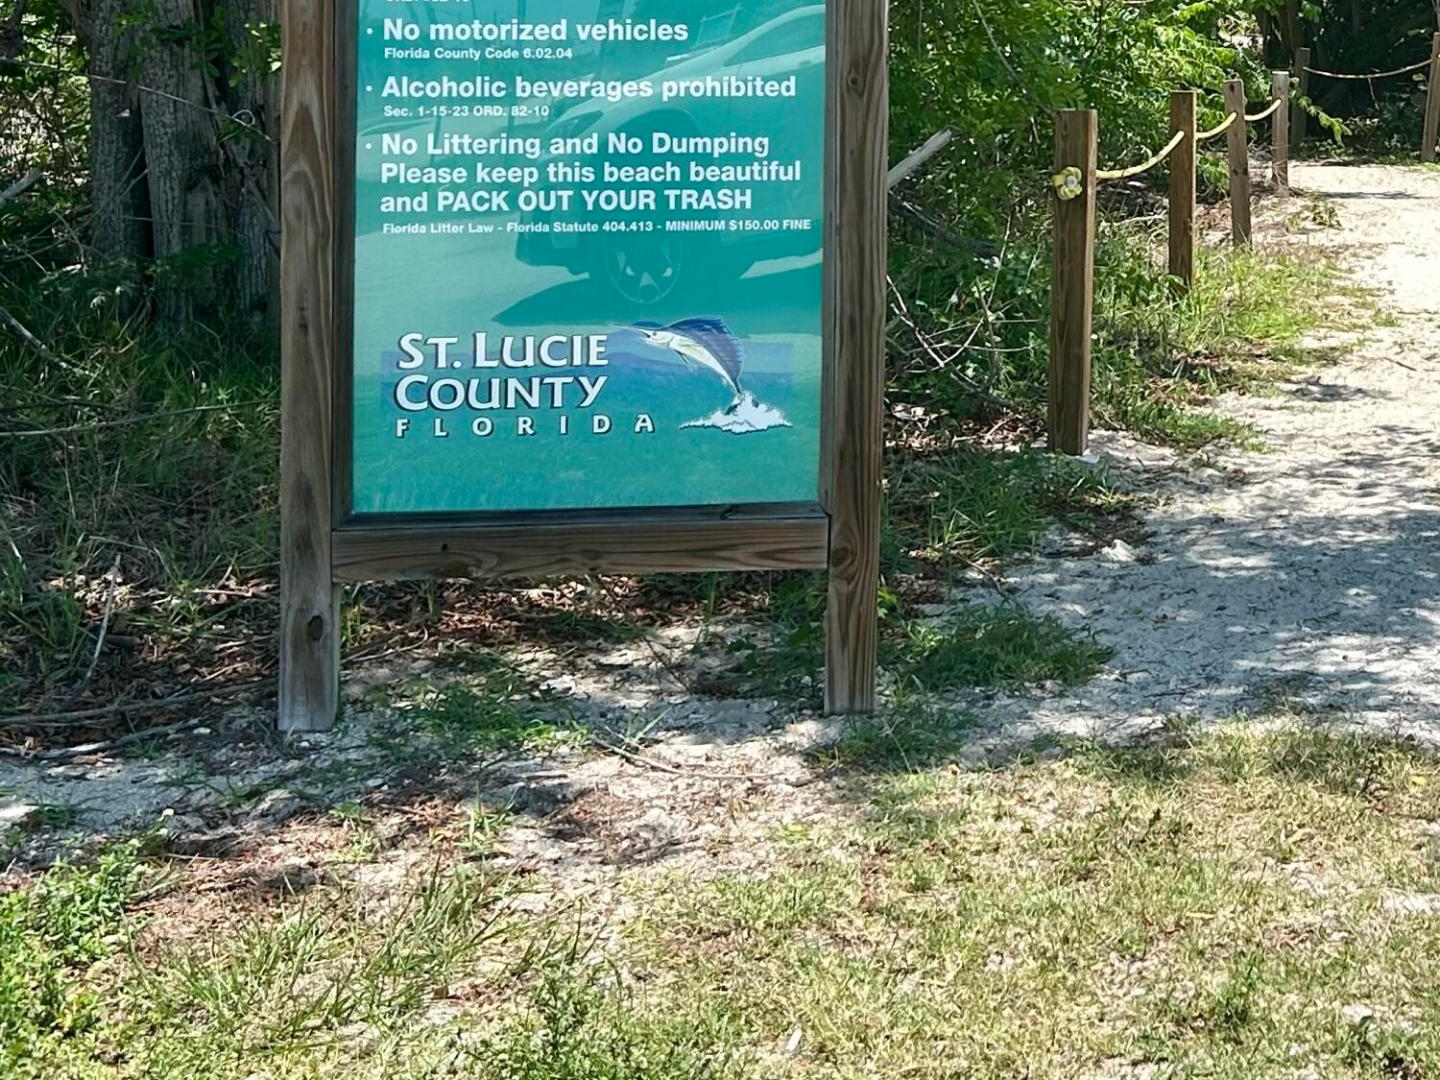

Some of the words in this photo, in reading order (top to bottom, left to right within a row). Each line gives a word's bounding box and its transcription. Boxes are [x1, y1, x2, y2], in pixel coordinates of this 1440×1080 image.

[384, 19, 421, 41] No
[429, 19, 567, 41] motorized
[576, 19, 688, 41] vehicles
[384, 47, 430, 60] Florida
[434, 48, 480, 61] County
[485, 47, 519, 59] Code
[523, 48, 573, 60] 6.02.04
[382, 76, 507, 98] Alcoholic
[515, 76, 653, 103] beverages
[662, 76, 796, 102] prohibited
[384, 105, 413, 117] Sec.
[418, 105, 469, 116] 1-15-23
[473, 105, 506, 116] ORD.
[511, 105, 550, 116] 82-10
[382, 134, 417, 155] No
[427, 134, 540, 159] Littering
[550, 133, 598, 154] and
[607, 133, 643, 154] No
[652, 132, 769, 159] Dumping
[381, 163, 467, 184] Please
[476, 162, 539, 187] keep
[547, 161, 595, 182] this
[604, 161, 681, 182] beach
[689, 160, 801, 182] beautiful
[381, 192, 428, 212] and
[437, 191, 509, 212] PACK
[518, 190, 570, 211] OUT
[581, 189, 656, 211] YOUR
[663, 188, 752, 209] TRASH
[383, 222, 426, 234] Florida
[430, 222, 464, 234] Litter
[468, 222, 494, 233] Law
[507, 222, 549, 233] Florida
[553, 221, 598, 233] Statute
[602, 221, 653, 232] 404.413
[665, 220, 726, 231] MINIMUM
[729, 219, 779, 232] $150.00
[783, 219, 811, 230] FINE
[397, 333, 461, 369] ST.
[474, 333, 609, 369] LUCIE
[394, 375, 608, 411] COUNTY
[396, 414, 655, 437] FLORIDA
